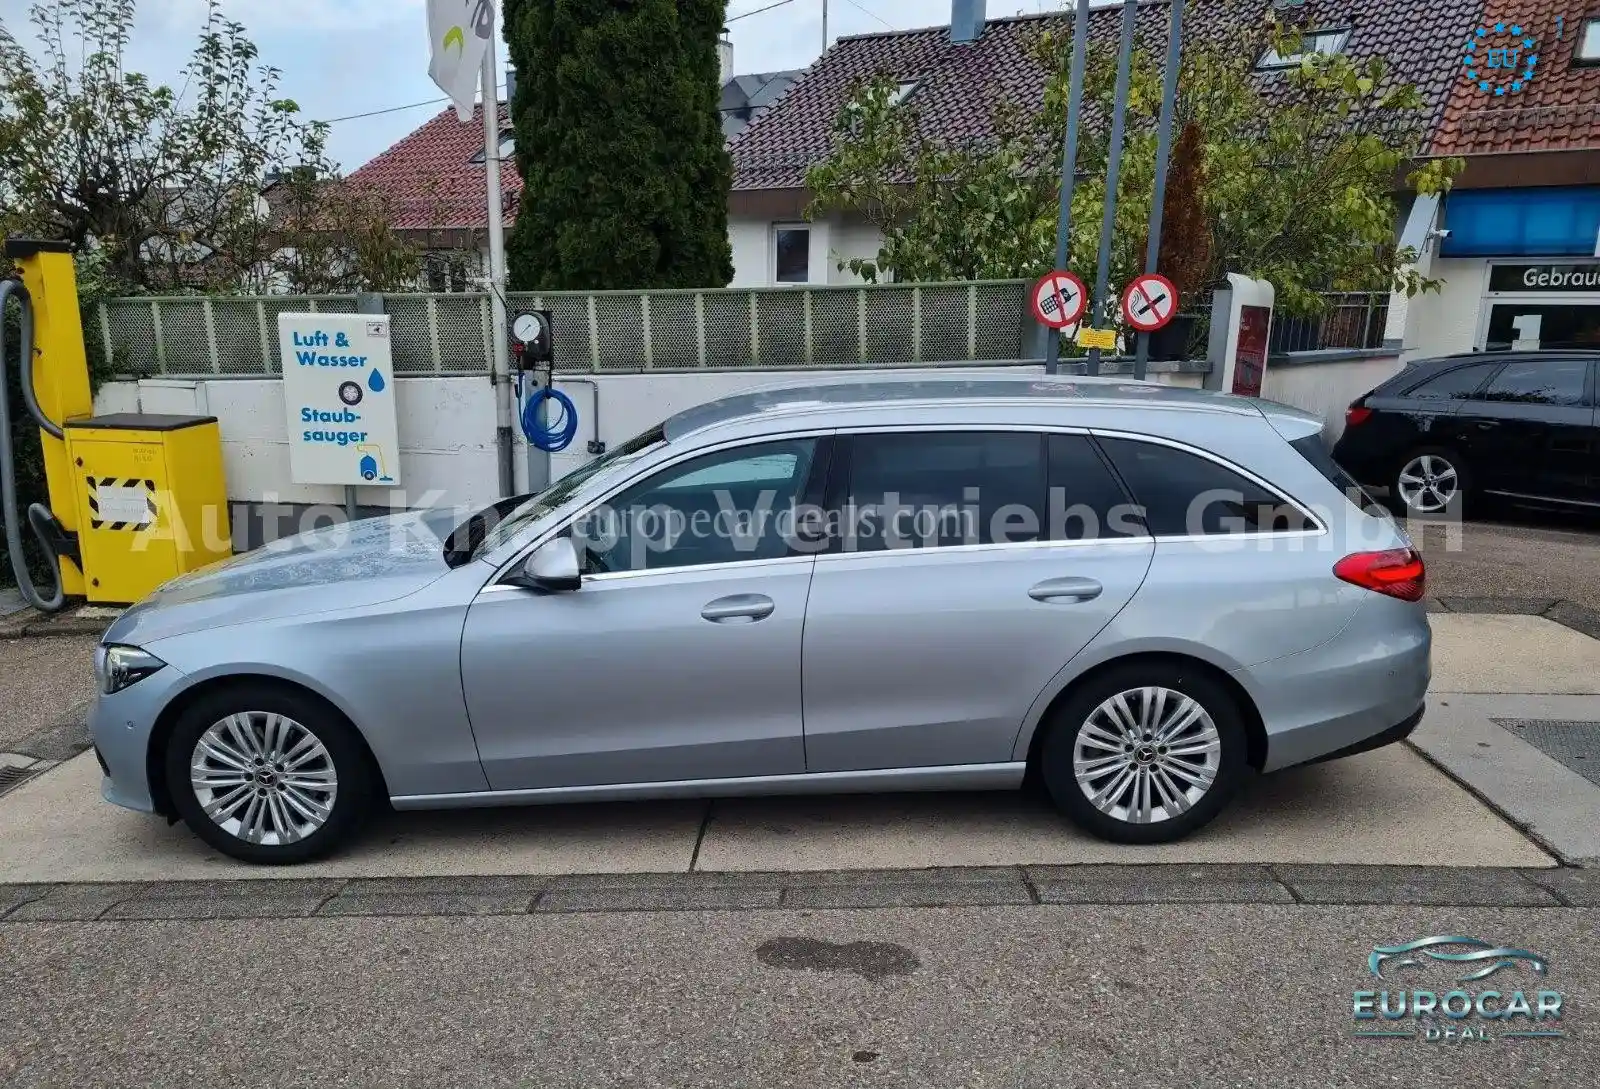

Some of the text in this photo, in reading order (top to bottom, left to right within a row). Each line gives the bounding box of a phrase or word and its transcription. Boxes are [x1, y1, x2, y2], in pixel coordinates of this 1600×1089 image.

[1523, 267, 1600, 287] Gebrau
[293, 331, 350, 347] Luft &
[296, 351, 368, 367] Wasser
[301, 407, 361, 423] Staub-
[303, 430, 368, 446] sauger
